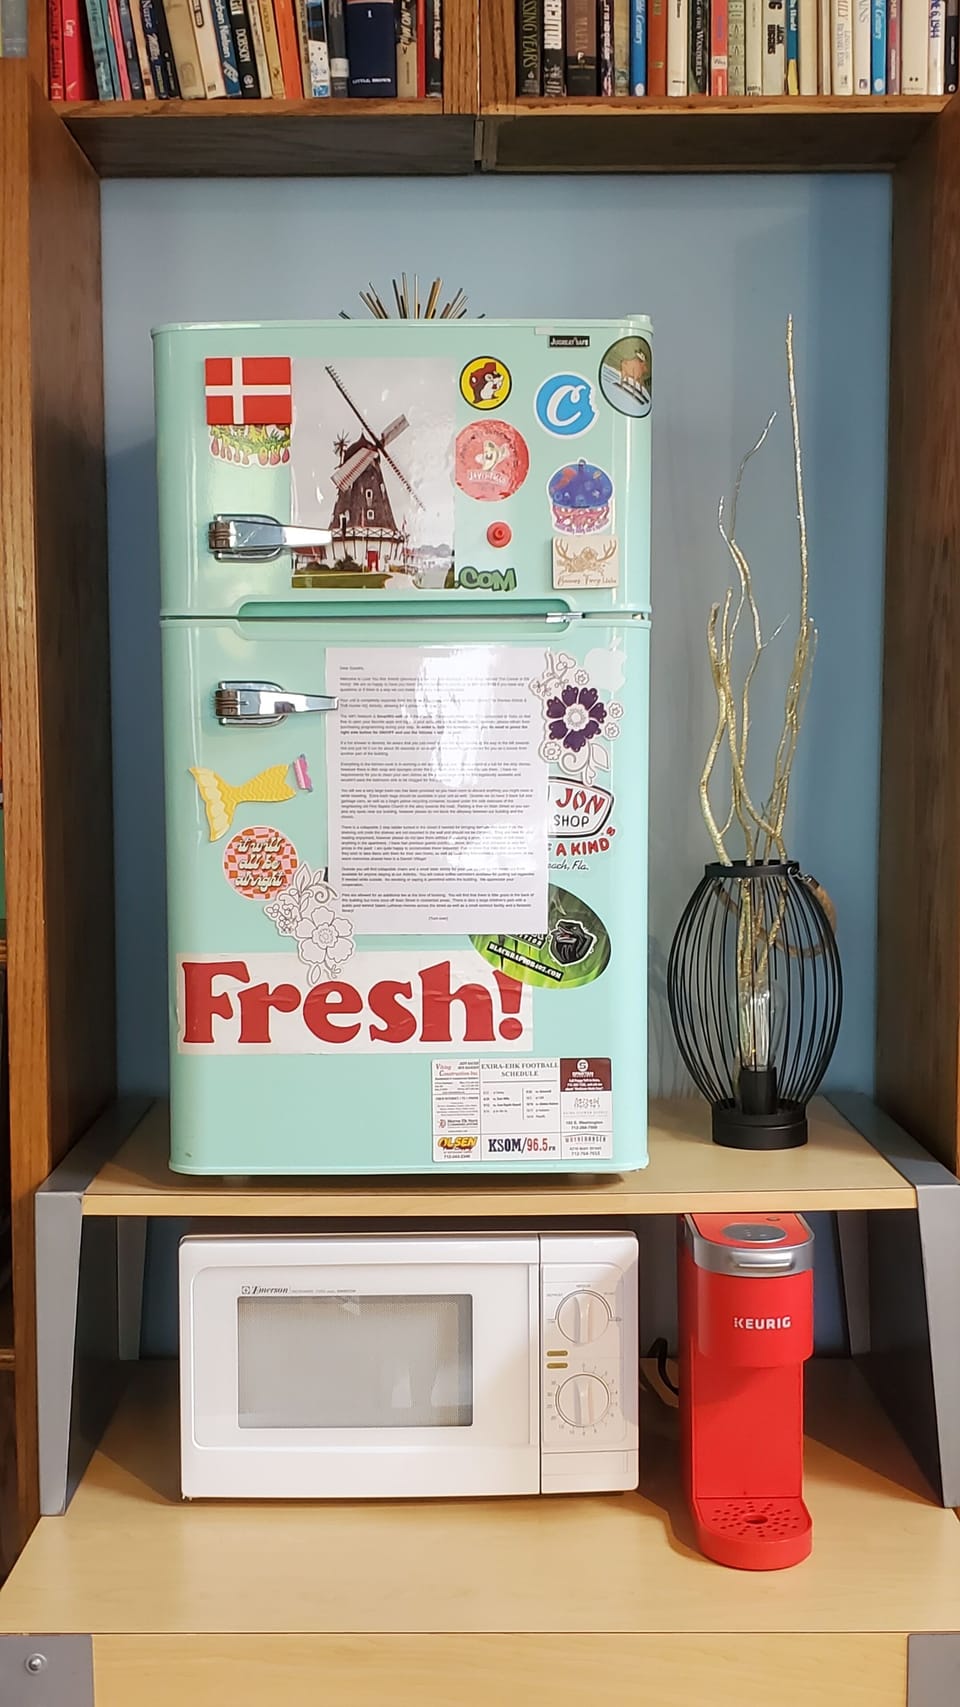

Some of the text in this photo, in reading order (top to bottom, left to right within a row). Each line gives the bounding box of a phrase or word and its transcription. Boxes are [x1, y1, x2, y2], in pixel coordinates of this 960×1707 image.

[142, 0, 153, 29] Nurse
[767, 24, 776, 55] HIGGINS
[776, 24, 785, 45] JACK
[929, 20, 941, 38] 1944
[219, 25, 231, 58] Nielsen
[235, 28, 251, 62] DOBSON
[523, 34, 539, 68] YEARS
[694, 30, 704, 76] WANDERER
[555, 787, 606, 815] JON
[553, 814, 590, 828] SHOP
[556, 842, 567, 857] A
[572, 860, 589, 871] Fla.
[181, 960, 524, 1043] Fresh!
[437, 1136, 478, 1149] OLSEN
[251, 1285, 289, 1294] Emerson
[734, 1316, 792, 1329] KEURIG
